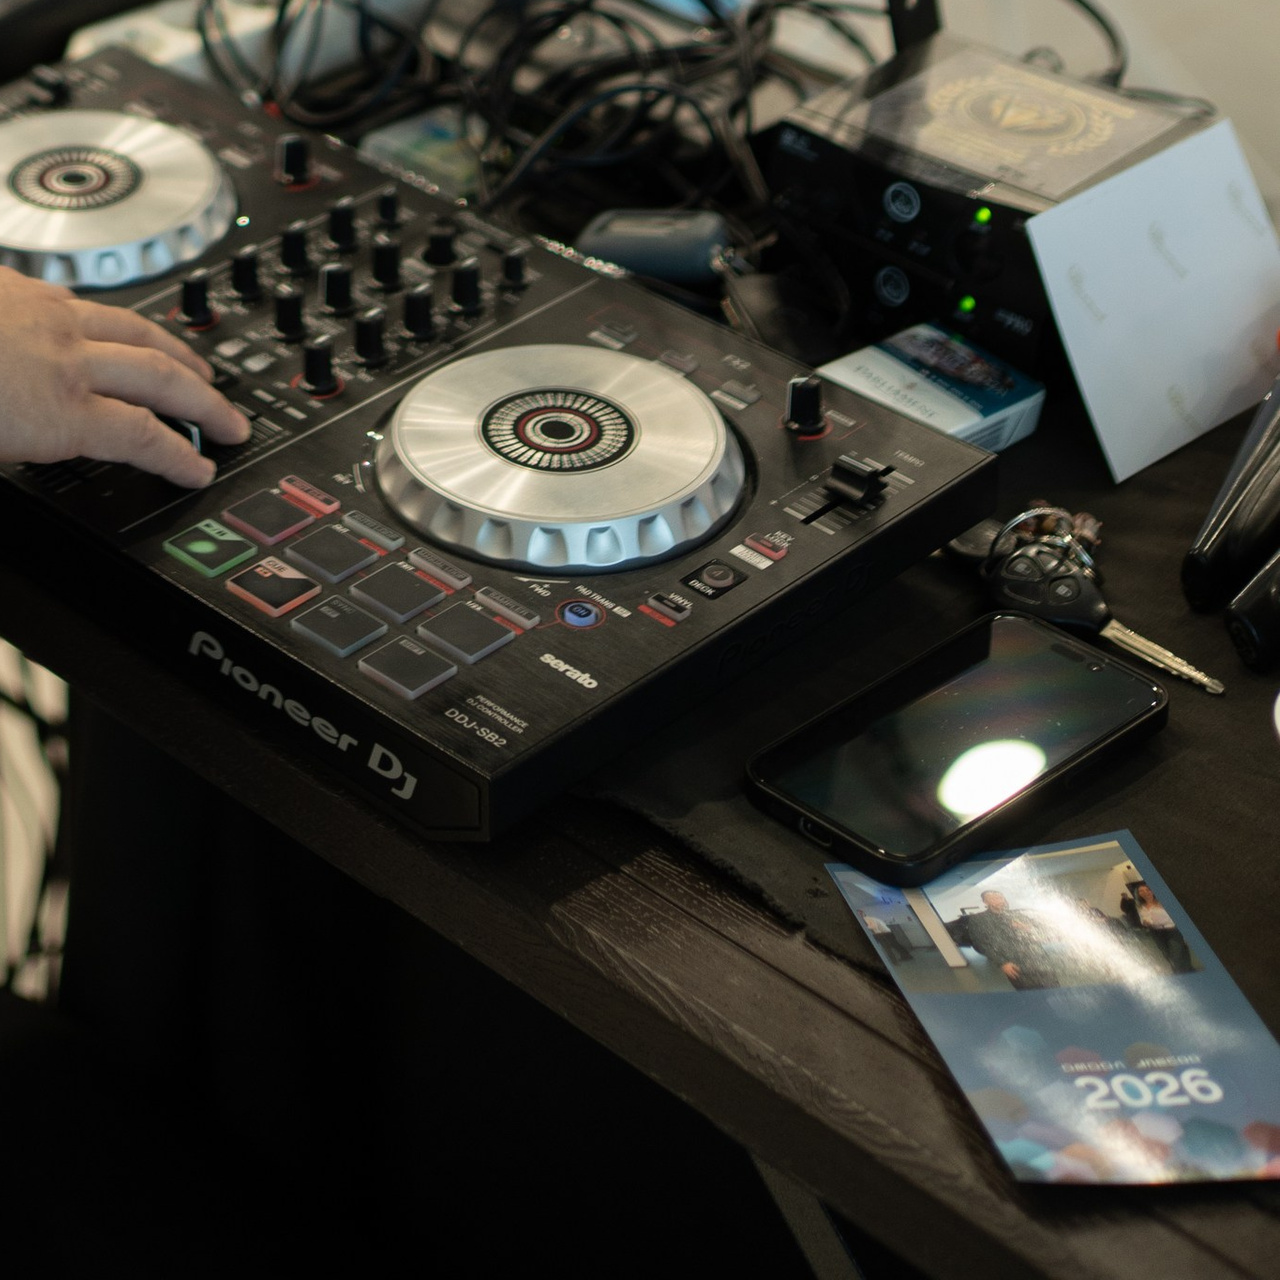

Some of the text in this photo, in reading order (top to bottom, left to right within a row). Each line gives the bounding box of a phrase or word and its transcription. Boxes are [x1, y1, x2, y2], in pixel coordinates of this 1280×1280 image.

[267, 560, 287, 573] CUE
[528, 584, 551, 597] FWD
[574, 585, 616, 609] PAD TRANS
[669, 592, 693, 607] VINYL
[688, 579, 716, 595] DECK
[573, 605, 591, 616] ON
[539, 653, 598, 688] serato
[188, 631, 417, 800] Pioneer DJ
[466, 698, 523, 733] DJ CONTROLLER
[475, 695, 529, 728] PERFORMANCE
[444, 708, 506, 747] DDJ-SB2
[1074, 1067, 1223, 1109] 2026
